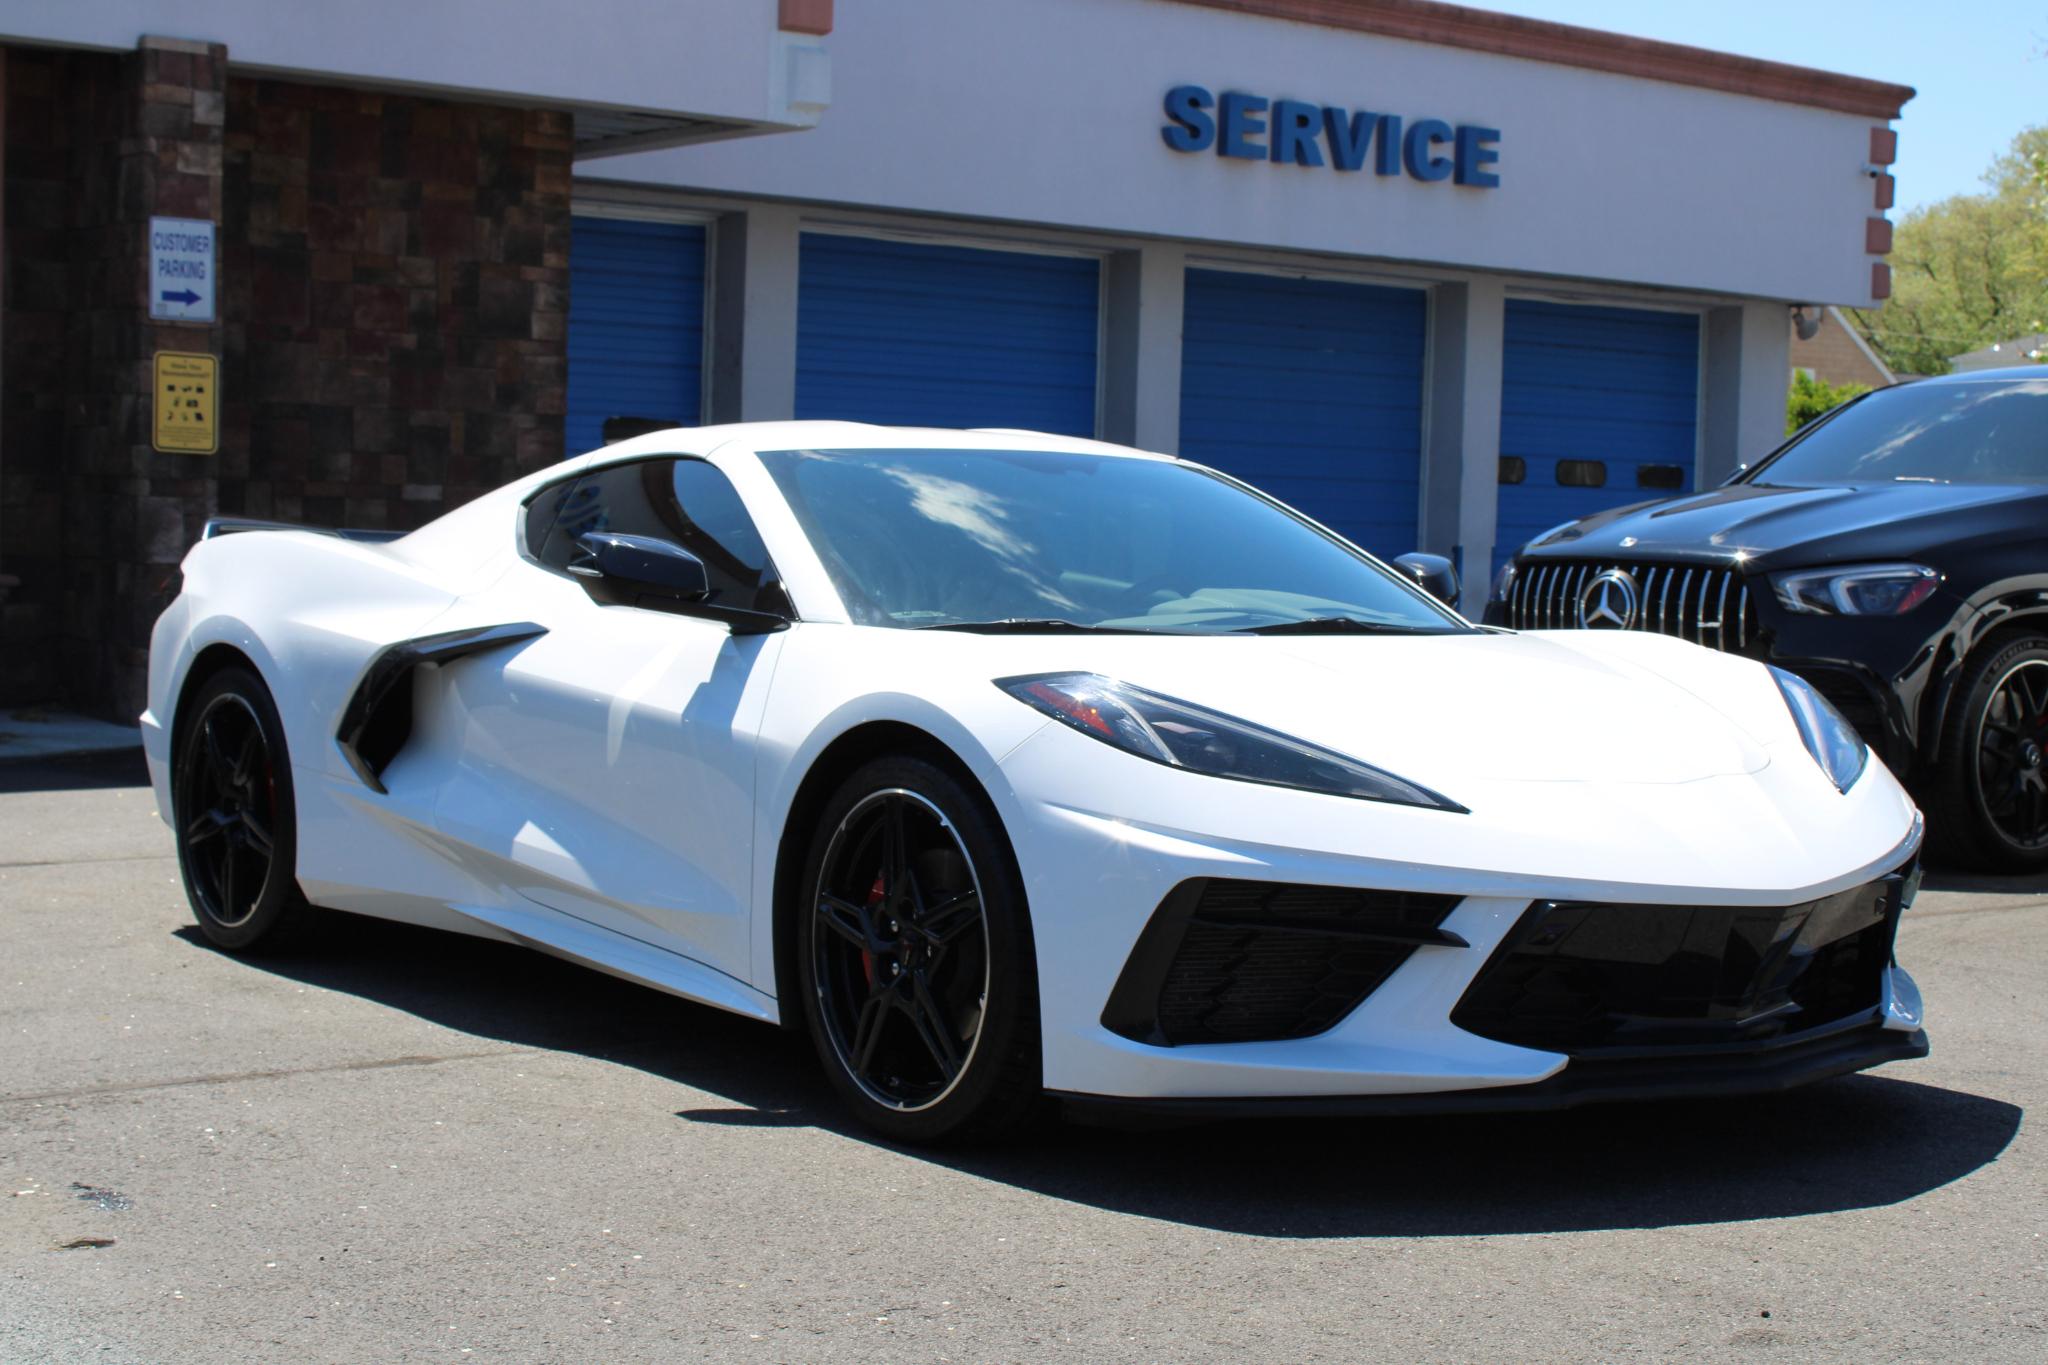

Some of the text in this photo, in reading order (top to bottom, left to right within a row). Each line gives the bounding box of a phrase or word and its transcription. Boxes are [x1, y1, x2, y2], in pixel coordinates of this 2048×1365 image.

[1161, 85, 1501, 188] SERVICE
[153, 232, 209, 254] CUSTOMER
[159, 258, 205, 280] PARKING
